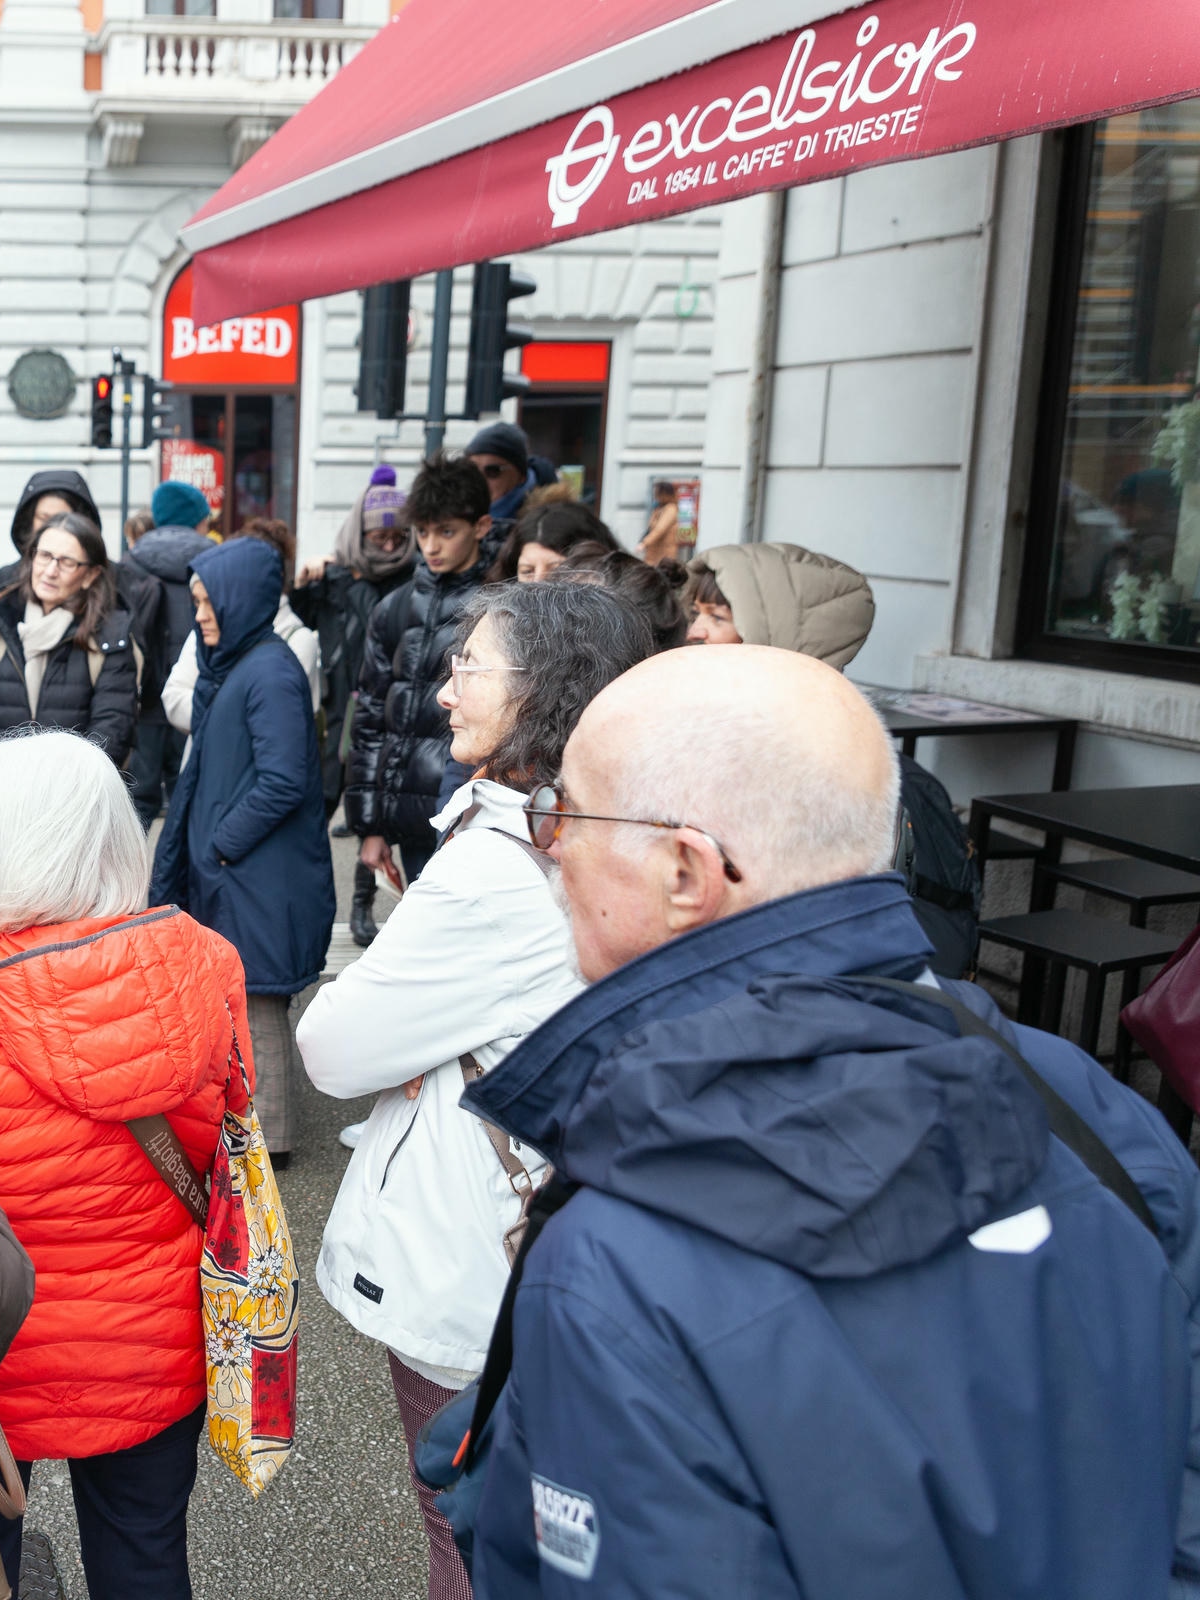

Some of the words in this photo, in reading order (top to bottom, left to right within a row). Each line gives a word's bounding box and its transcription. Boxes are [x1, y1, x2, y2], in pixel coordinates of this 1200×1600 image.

[628, 177, 659, 205] DAL
[664, 165, 702, 195] 1954
[702, 161, 718, 186] IL
[793, 133, 818, 161] DI
[823, 105, 923, 155] TRIESTE
[171, 316, 293, 359] BEFED
[145, 1130, 192, 1197] Biagiotti
[189, 1183, 209, 1220] aura
